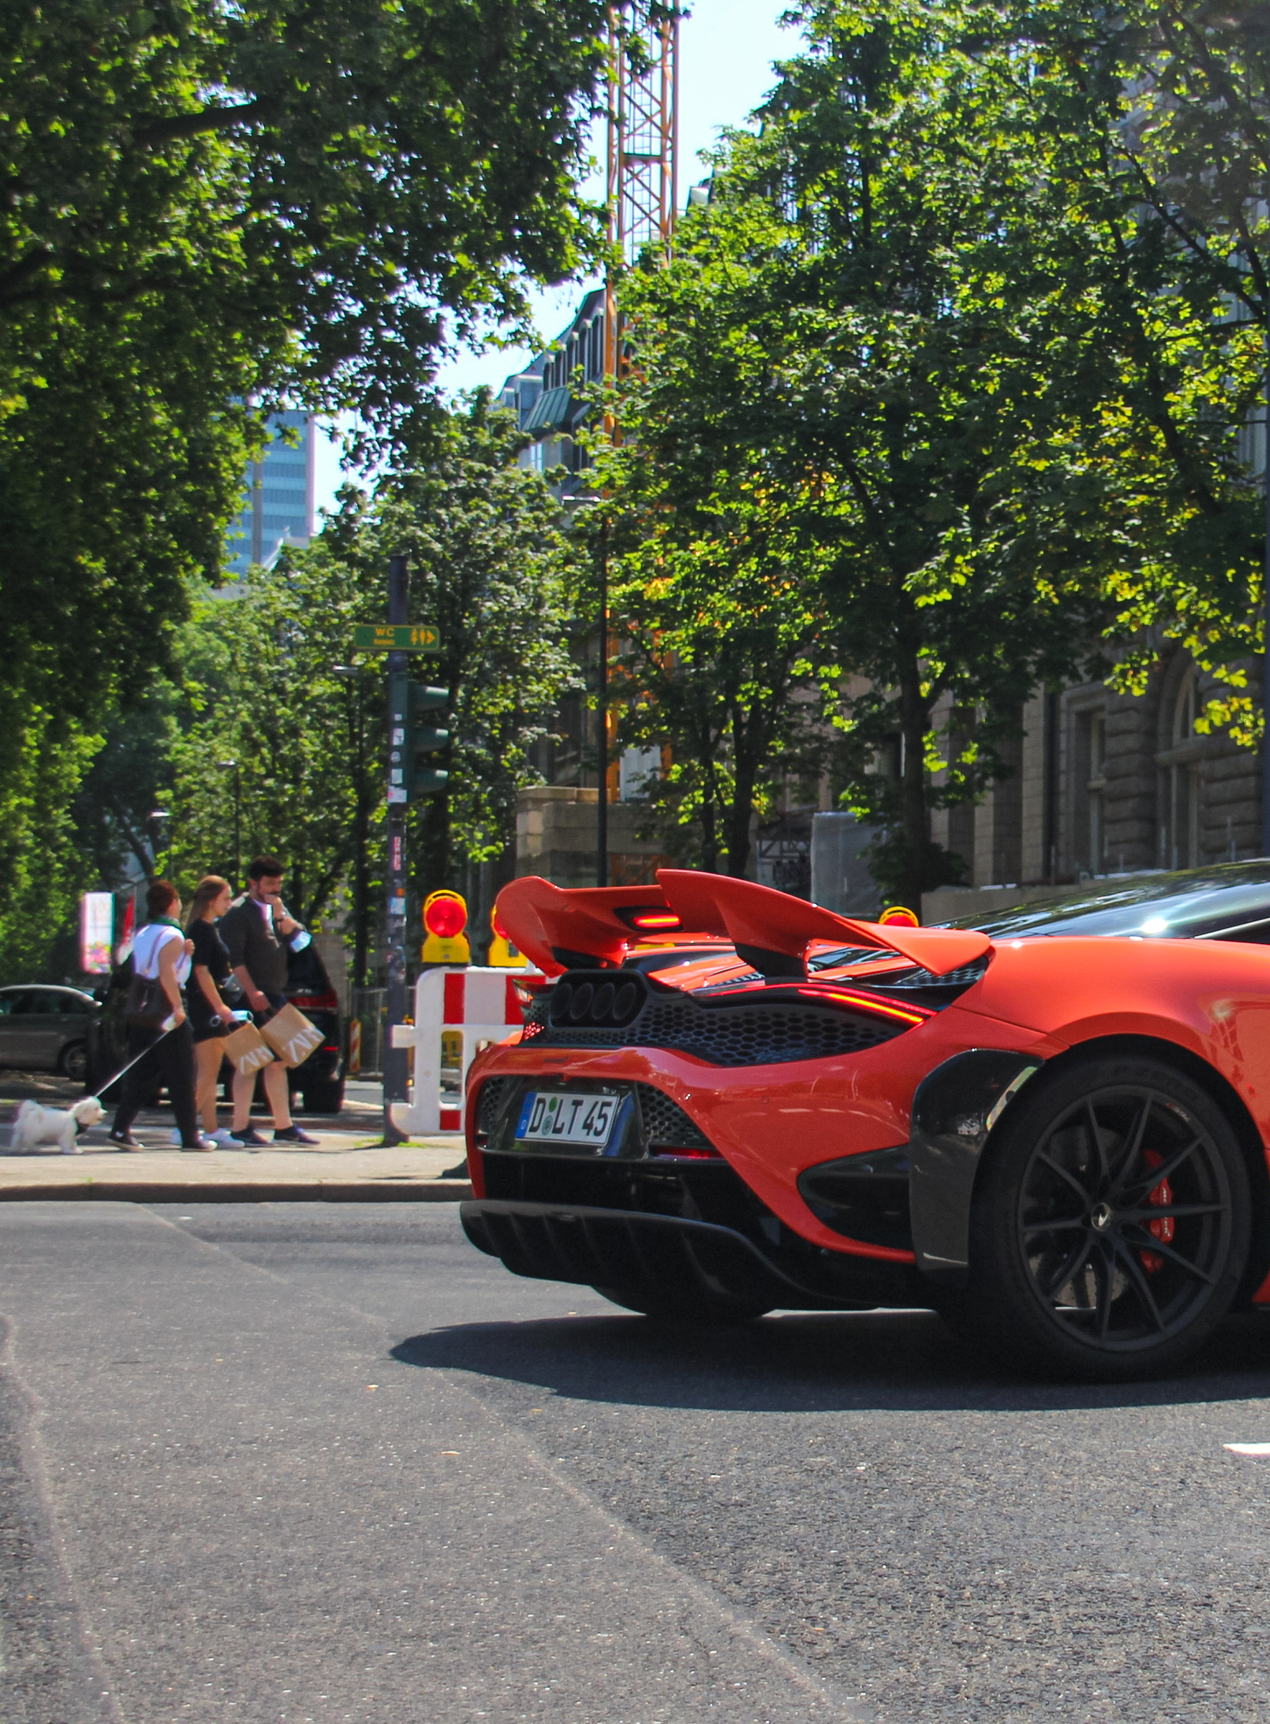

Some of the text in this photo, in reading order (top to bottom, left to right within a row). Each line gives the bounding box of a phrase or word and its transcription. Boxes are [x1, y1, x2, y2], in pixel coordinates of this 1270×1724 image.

[374, 627, 395, 637] WC
[529, 1097, 612, 1136] D LT 45
